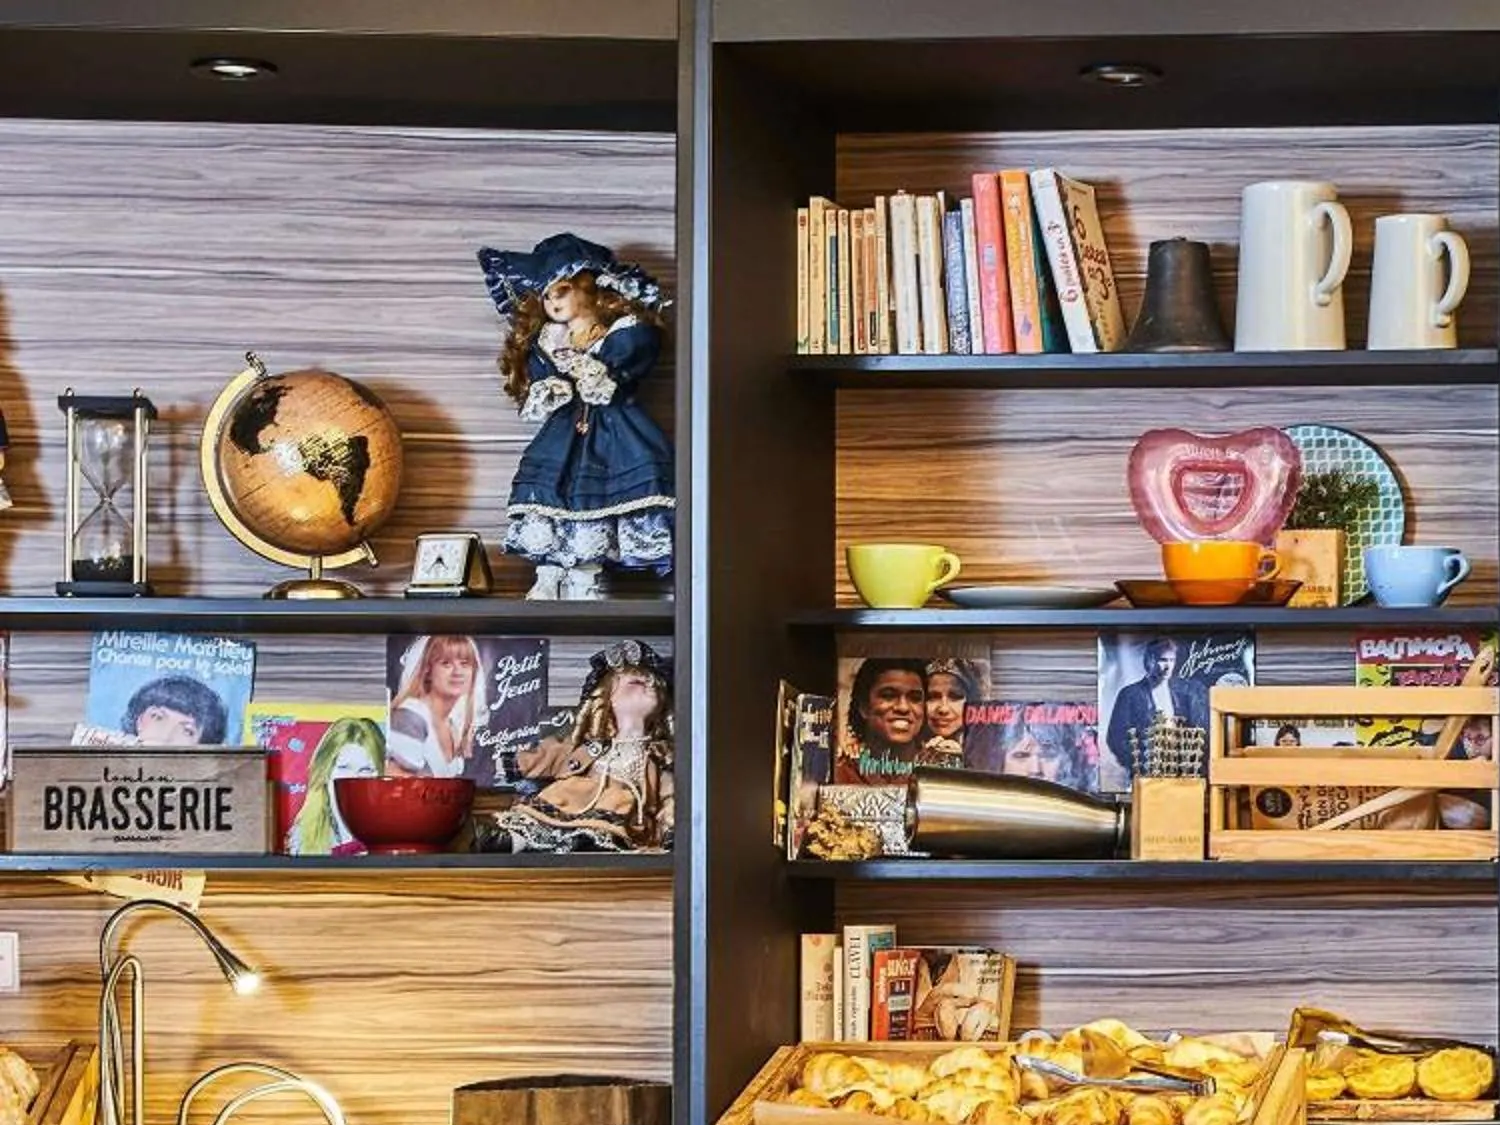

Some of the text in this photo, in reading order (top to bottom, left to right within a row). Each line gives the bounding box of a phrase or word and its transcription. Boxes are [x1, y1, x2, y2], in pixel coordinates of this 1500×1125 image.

[98, 631, 170, 653] Mireille
[1359, 633, 1475, 662] BALTIMORA
[155, 655, 191, 671] pour
[494, 652, 543, 682] Petit
[489, 677, 541, 711] Jean
[43, 785, 233, 832] BRASSERIE
